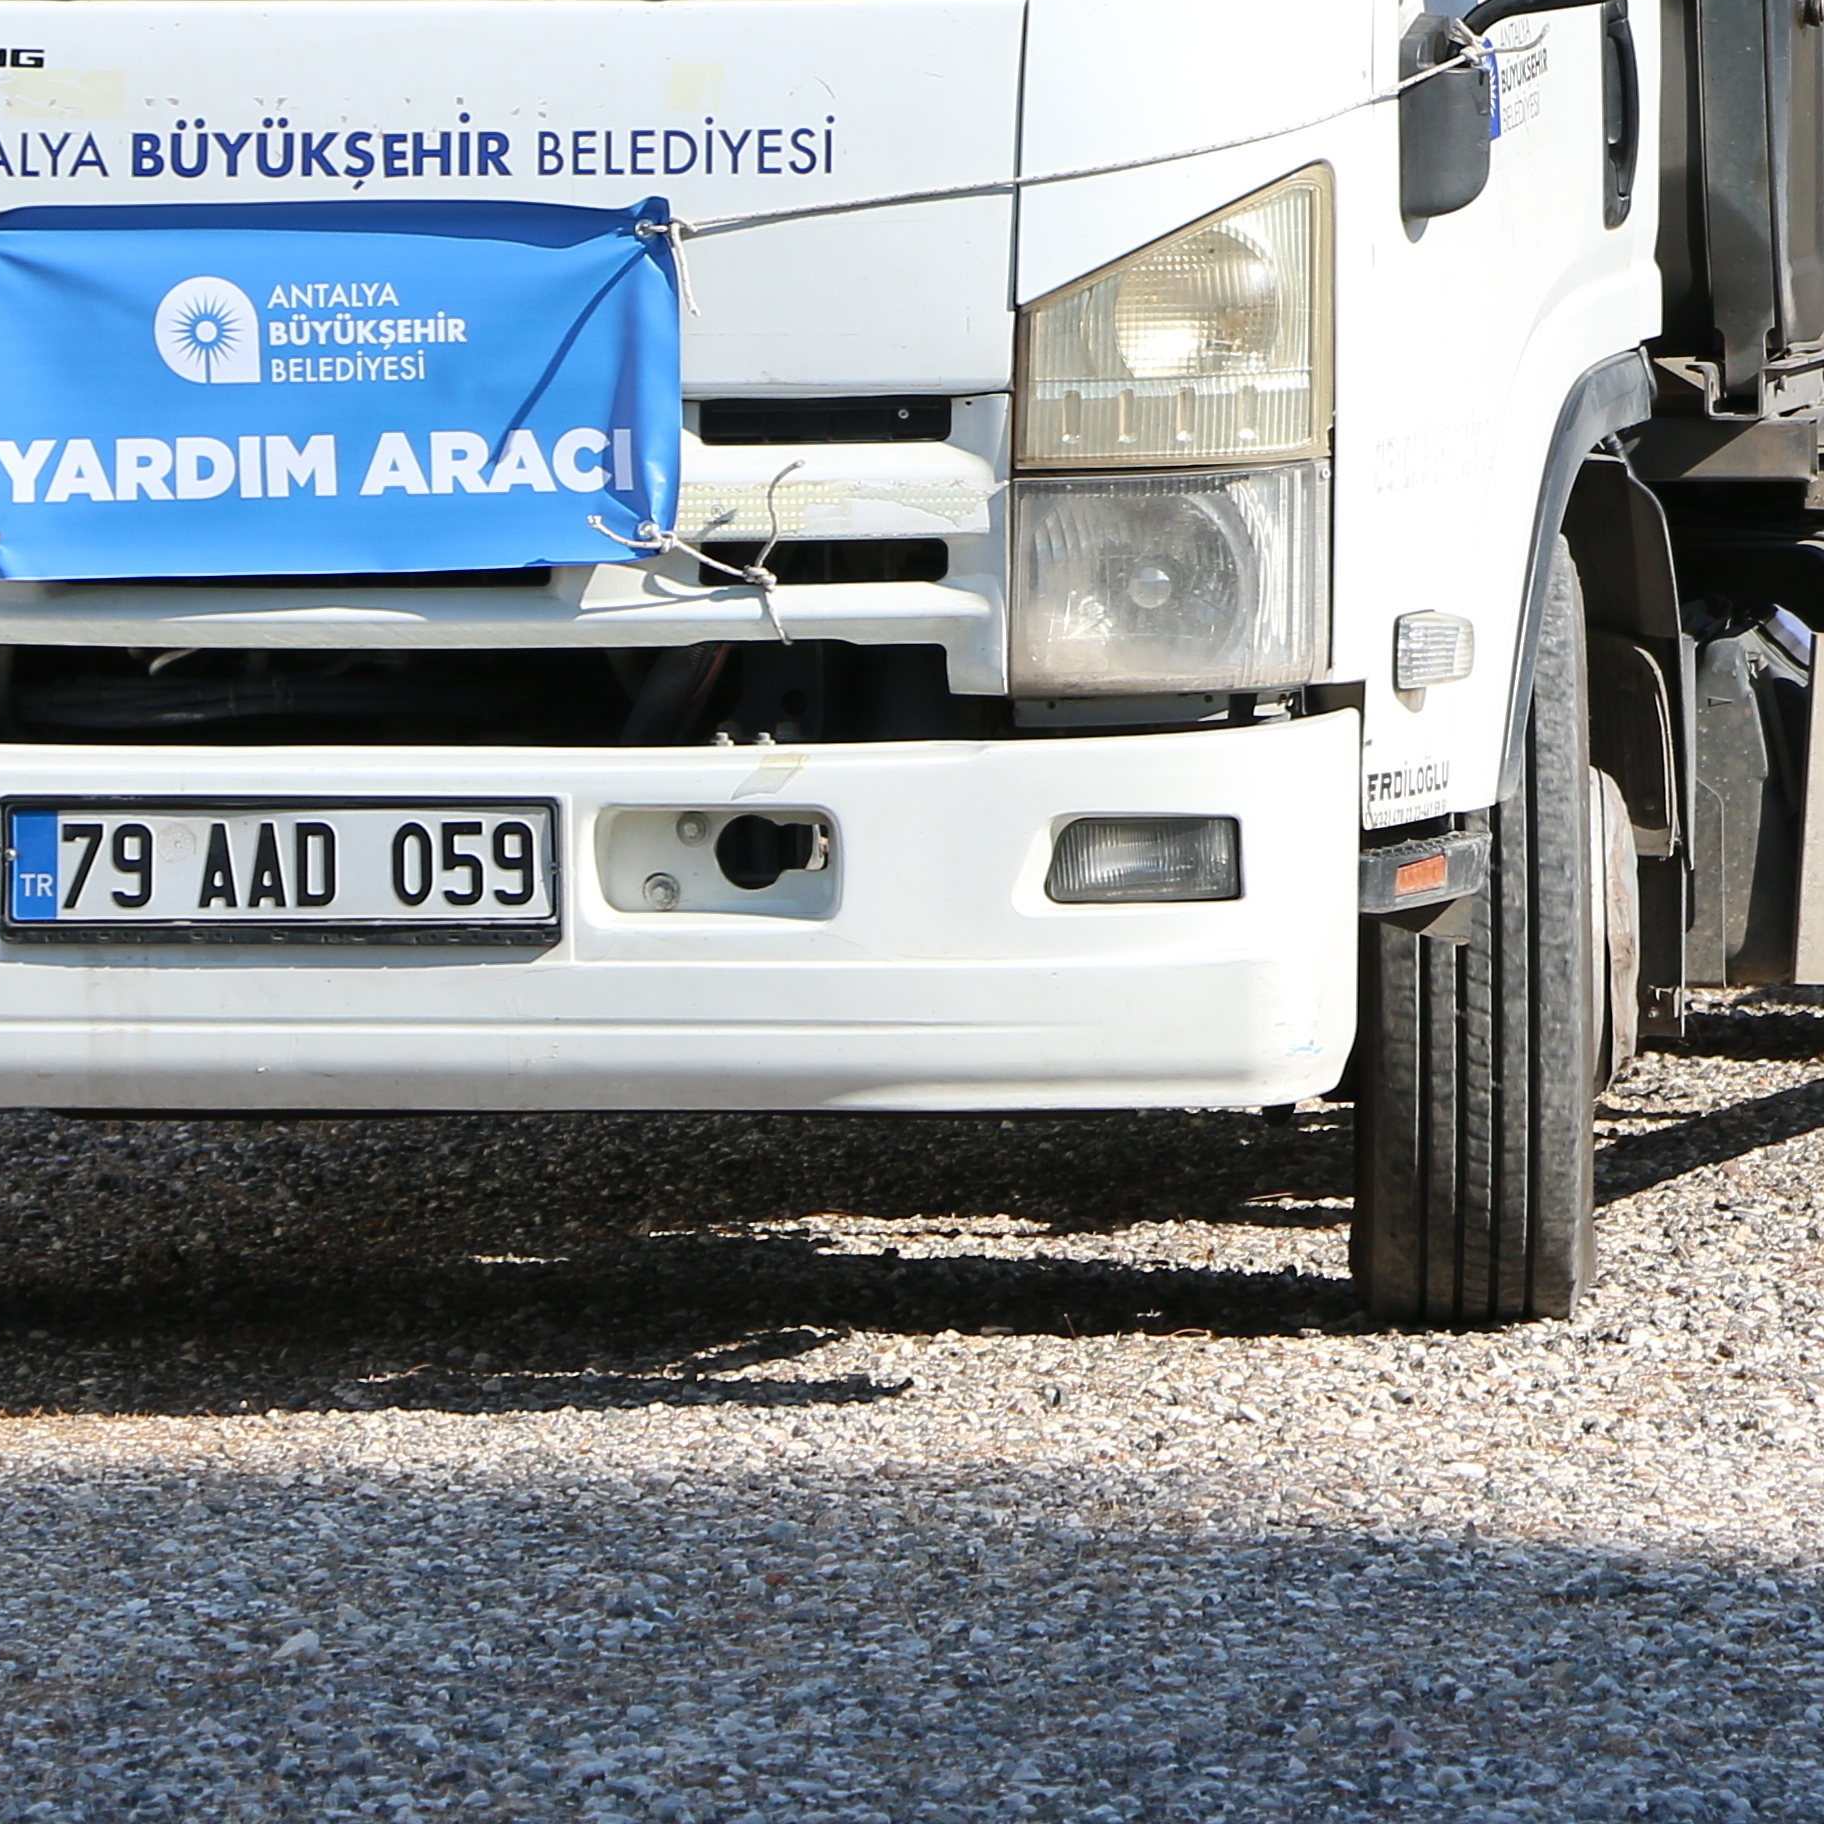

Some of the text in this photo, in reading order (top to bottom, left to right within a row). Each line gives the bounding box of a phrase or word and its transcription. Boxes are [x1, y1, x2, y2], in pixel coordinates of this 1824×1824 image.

[131, 112, 513, 190] BÜYÜKŞEHİR
[538, 115, 835, 176] BELEDİYESİ
[267, 282, 400, 309] ANTALYA
[268, 310, 468, 351] BÜYÜKŞEHİR
[271, 349, 425, 383] BELEDİYESİ
[358, 426, 635, 495] ARACI
[19, 873, 54, 898] TR
[62, 821, 534, 909] 79 AAD 059
